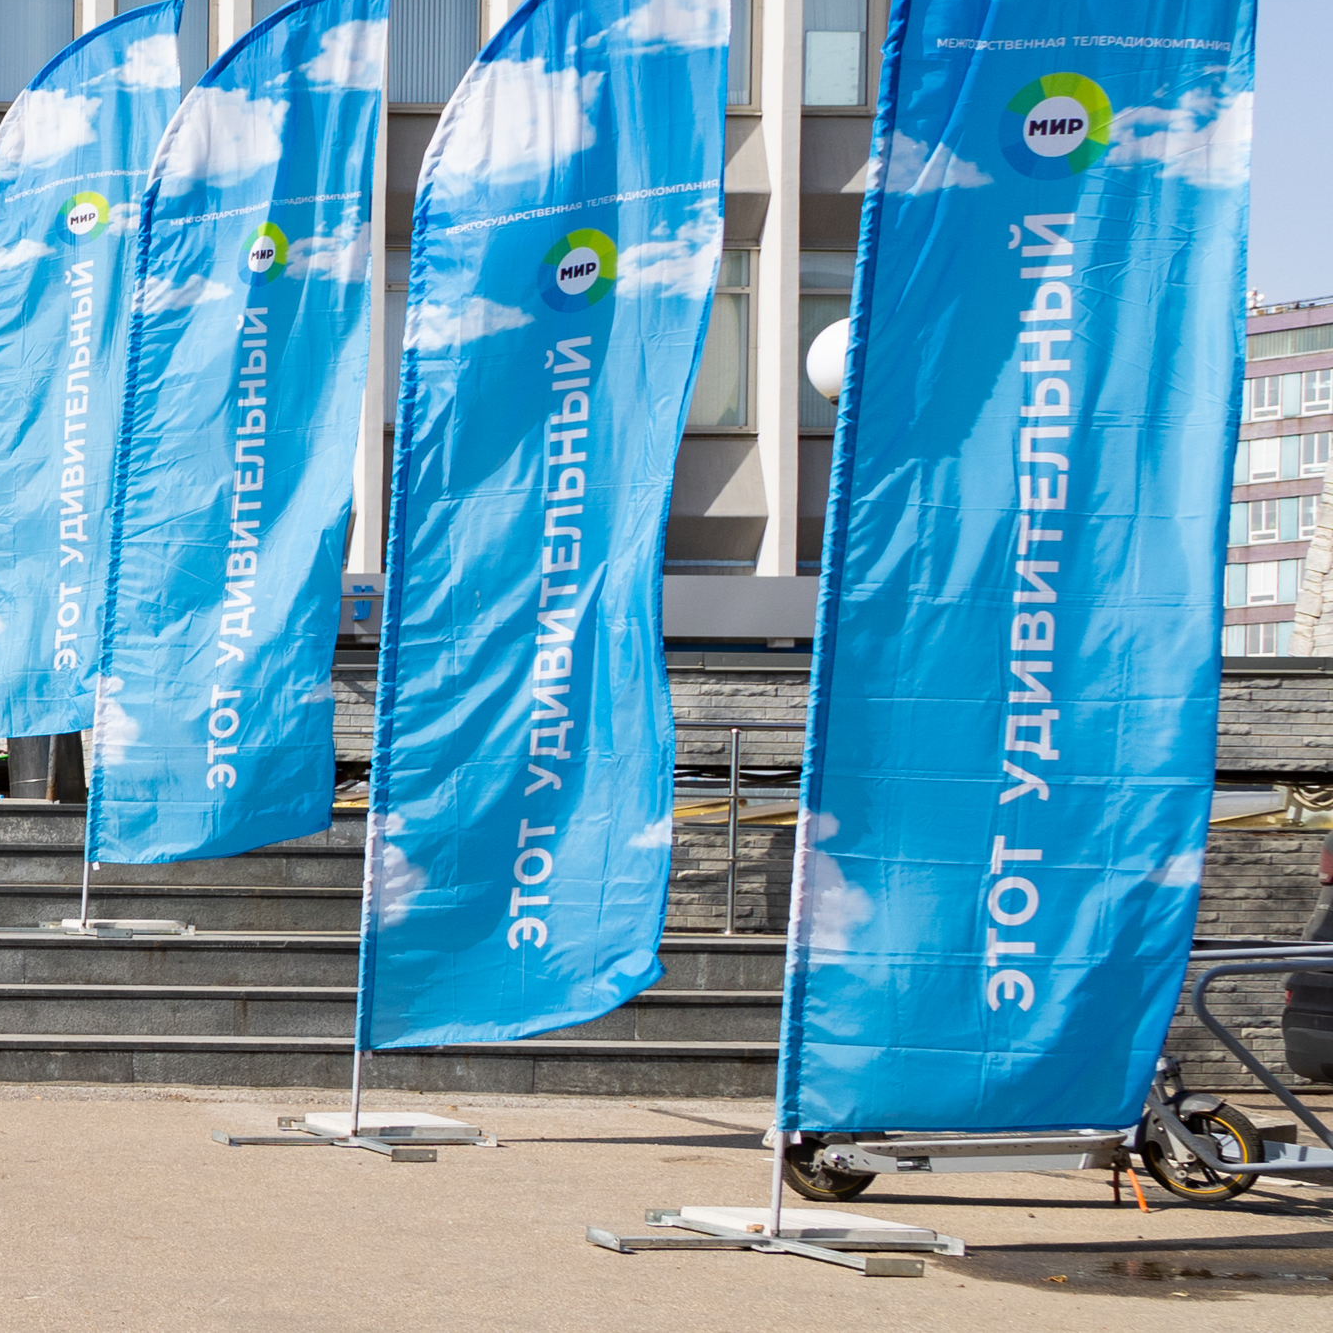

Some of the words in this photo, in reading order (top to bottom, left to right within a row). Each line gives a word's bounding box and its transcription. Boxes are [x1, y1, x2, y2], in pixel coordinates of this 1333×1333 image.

[1072, 35, 1232, 52] ТЕЛЕРАДИОКОМПАНИЯ
[1028, 118, 1084, 137] МИР
[70, 212, 96, 226] МИР
[251, 249, 274, 261] МИР
[445, 201, 583, 236] МЕЖГОСУДАРСТВЕННАЯ
[585, 178, 719, 208] ТЕЛЕРАДИОКОМПАНИЯ
[559, 261, 597, 281] МИР
[59, 258, 95, 568] УДИВИТЕЛЬНЫЙ
[214, 306, 269, 669] УДИВИТЕЛЬНЫЙ
[998, 212, 1077, 805] УДИВИТЕЛЬНЫЙ
[524, 335, 593, 798] УДИВИТЕЛЬНЫЙ
[53, 582, 83, 672] ЭТОТ
[206, 684, 241, 791] ЭТОТ
[507, 817, 557, 951] ЭТОТ
[986, 833, 1044, 1013] ЭТОТ
